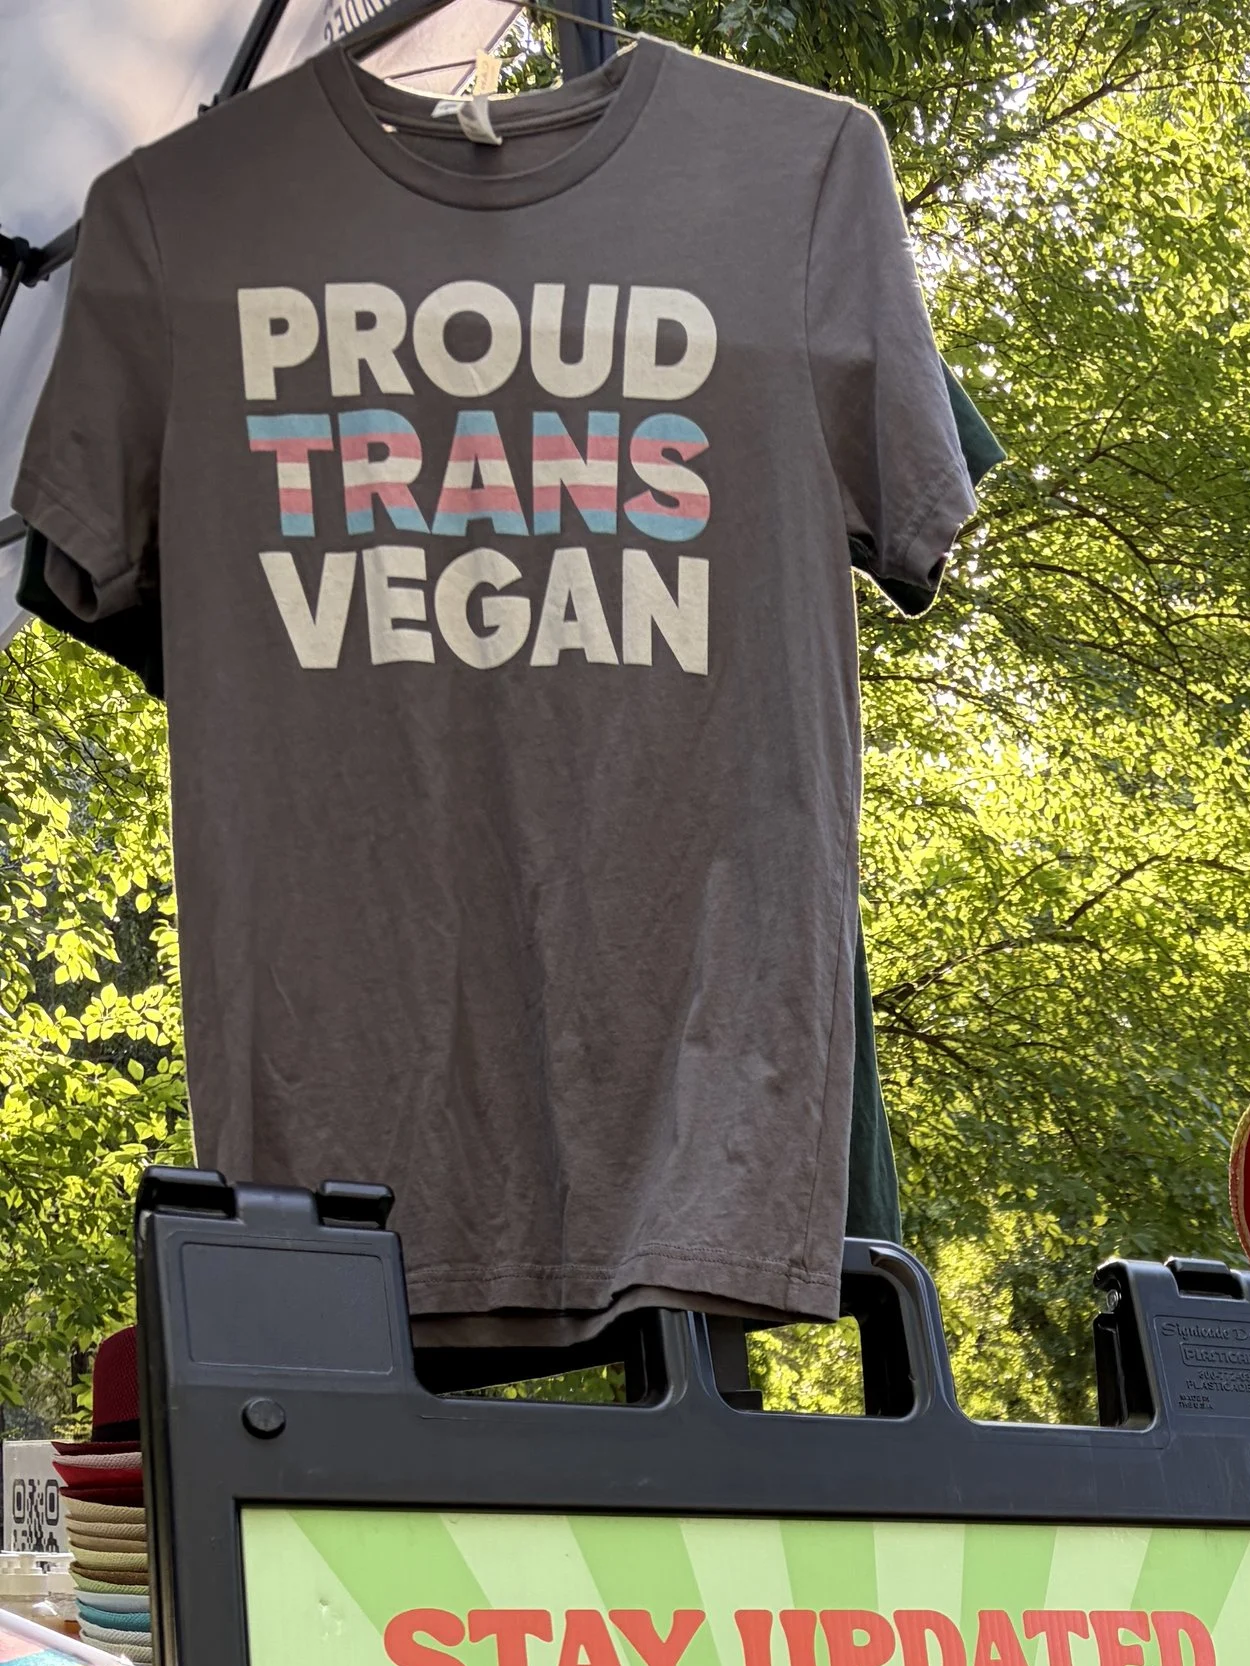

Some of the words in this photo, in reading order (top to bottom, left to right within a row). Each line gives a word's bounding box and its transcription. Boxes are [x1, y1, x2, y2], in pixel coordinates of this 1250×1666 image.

[238, 280, 717, 401] PROUD
[247, 409, 711, 542] TRANS
[259, 544, 710, 676] VEGAN
